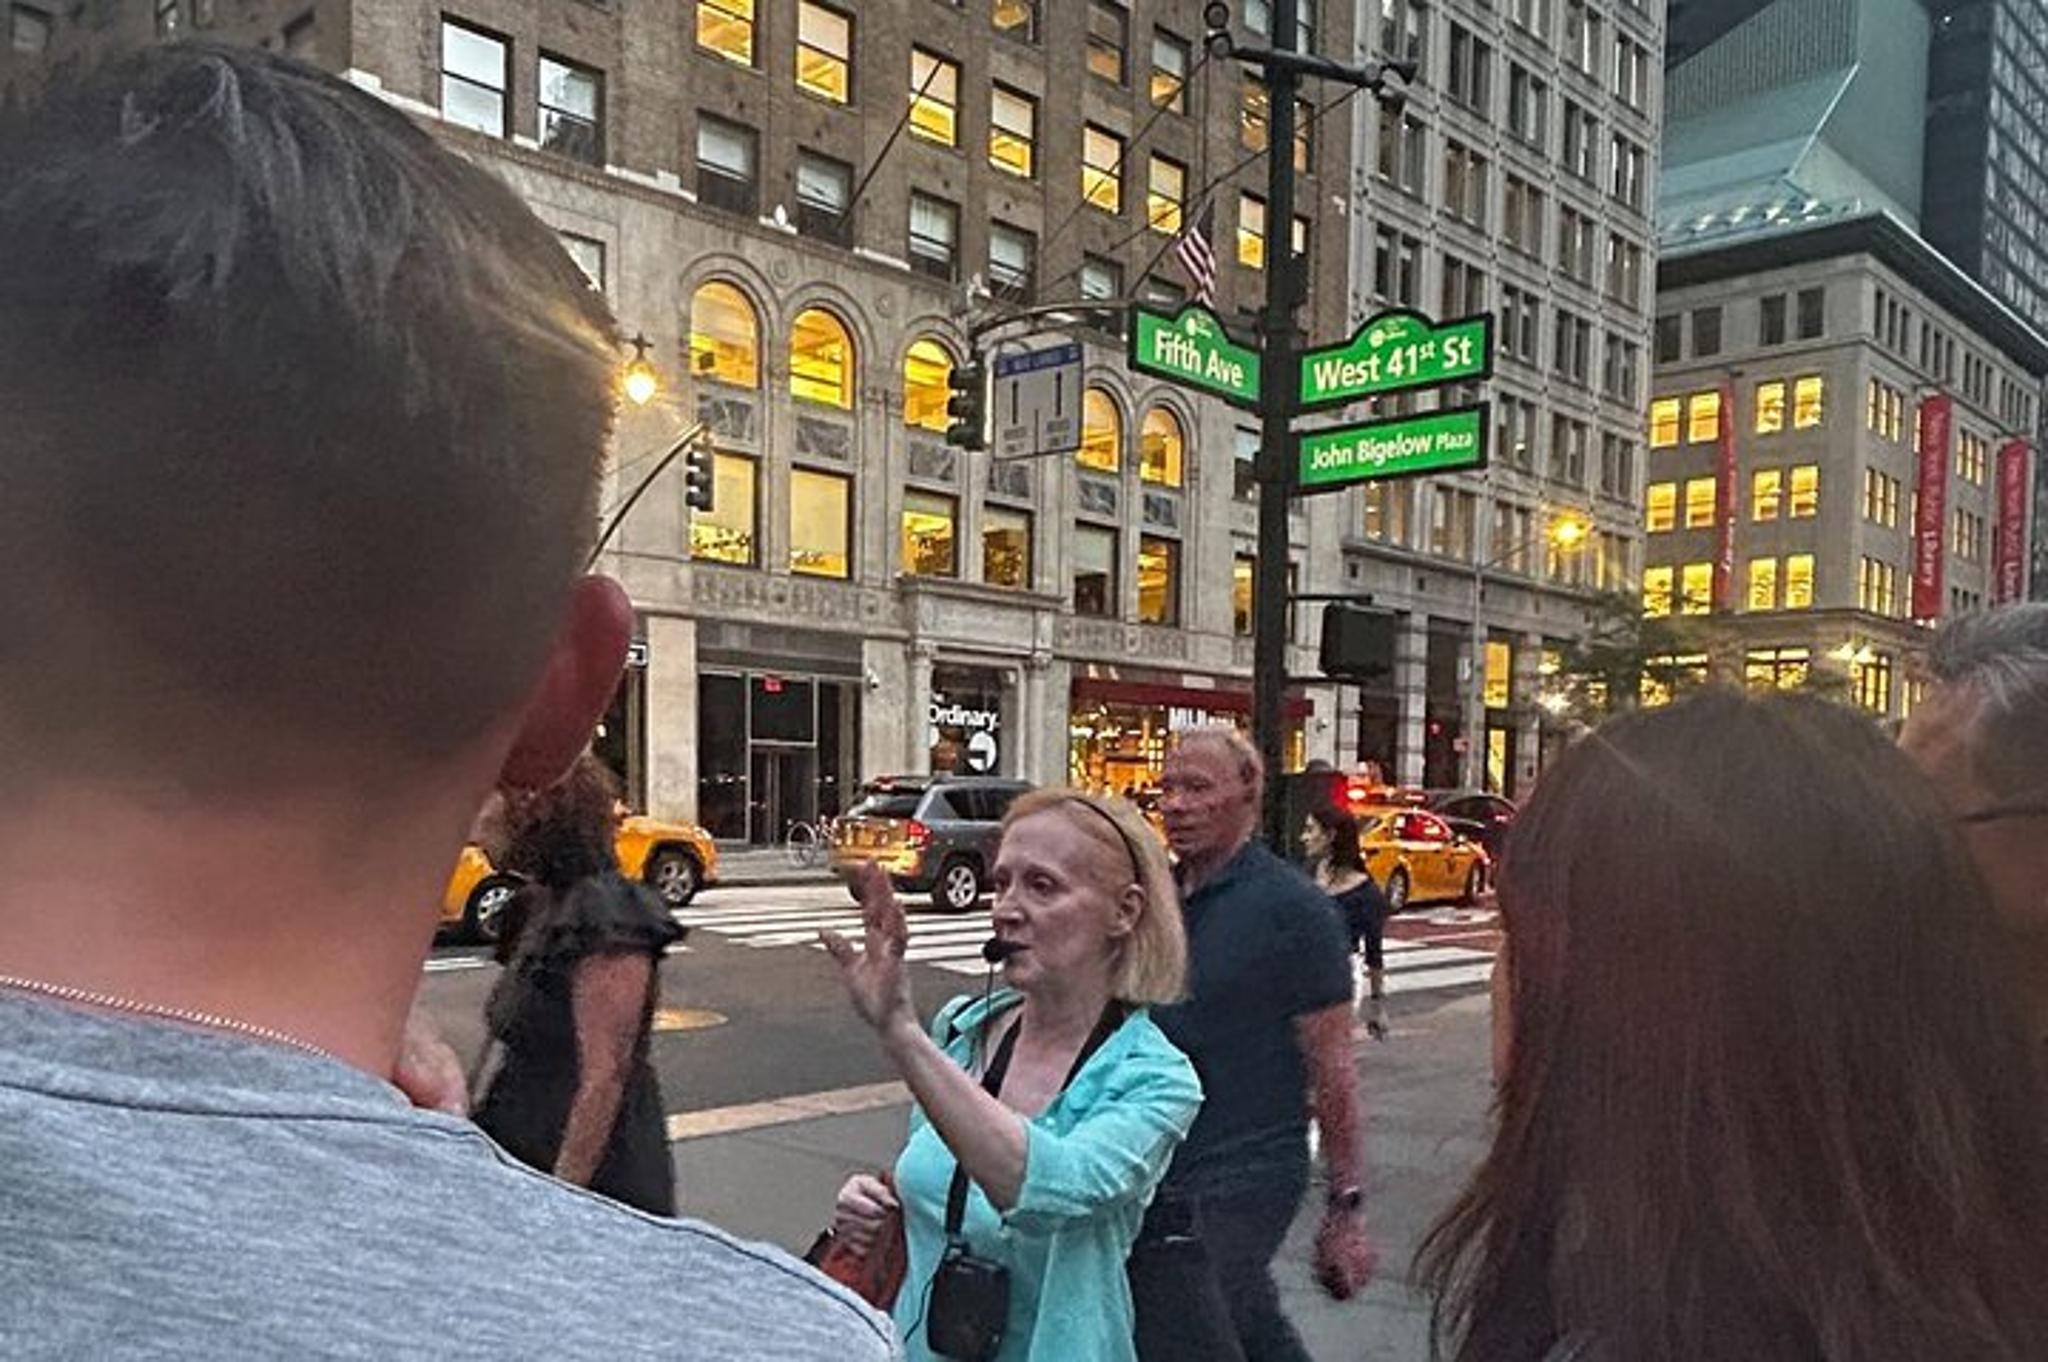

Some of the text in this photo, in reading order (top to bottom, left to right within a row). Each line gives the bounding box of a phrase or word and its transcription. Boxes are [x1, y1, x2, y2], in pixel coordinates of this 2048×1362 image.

[1155, 328, 1244, 388] Fifth Ave
[1313, 335, 1473, 392] West 41st St
[1311, 431, 1474, 470] John Bigelow Plaza
